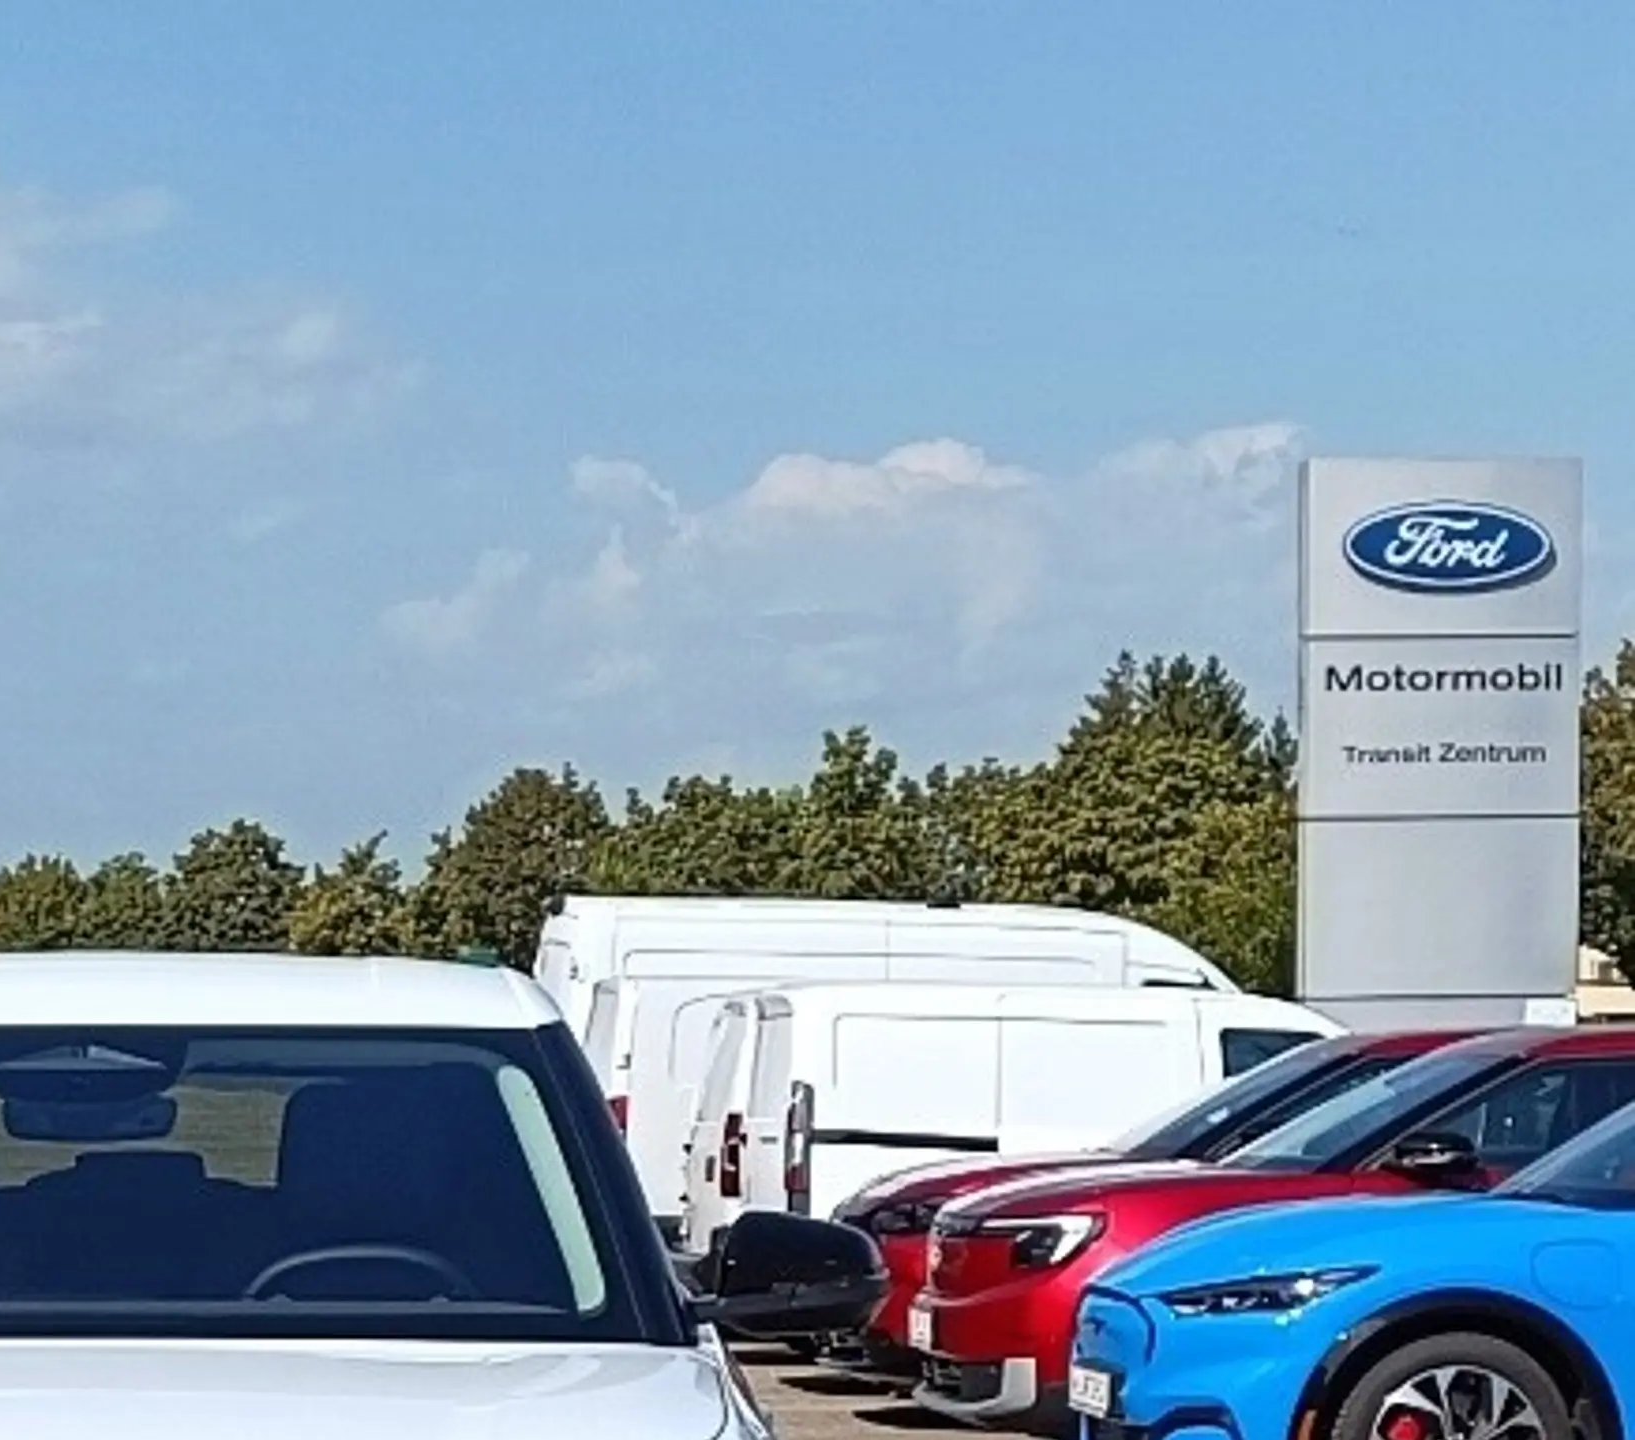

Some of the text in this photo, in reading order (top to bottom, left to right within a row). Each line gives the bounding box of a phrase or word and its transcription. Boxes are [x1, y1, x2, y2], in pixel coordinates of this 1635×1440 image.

[1383, 516, 1509, 568] Ford
[1324, 663, 1563, 692] Motormobil
[1341, 742, 1547, 764] Transit Zentrum
